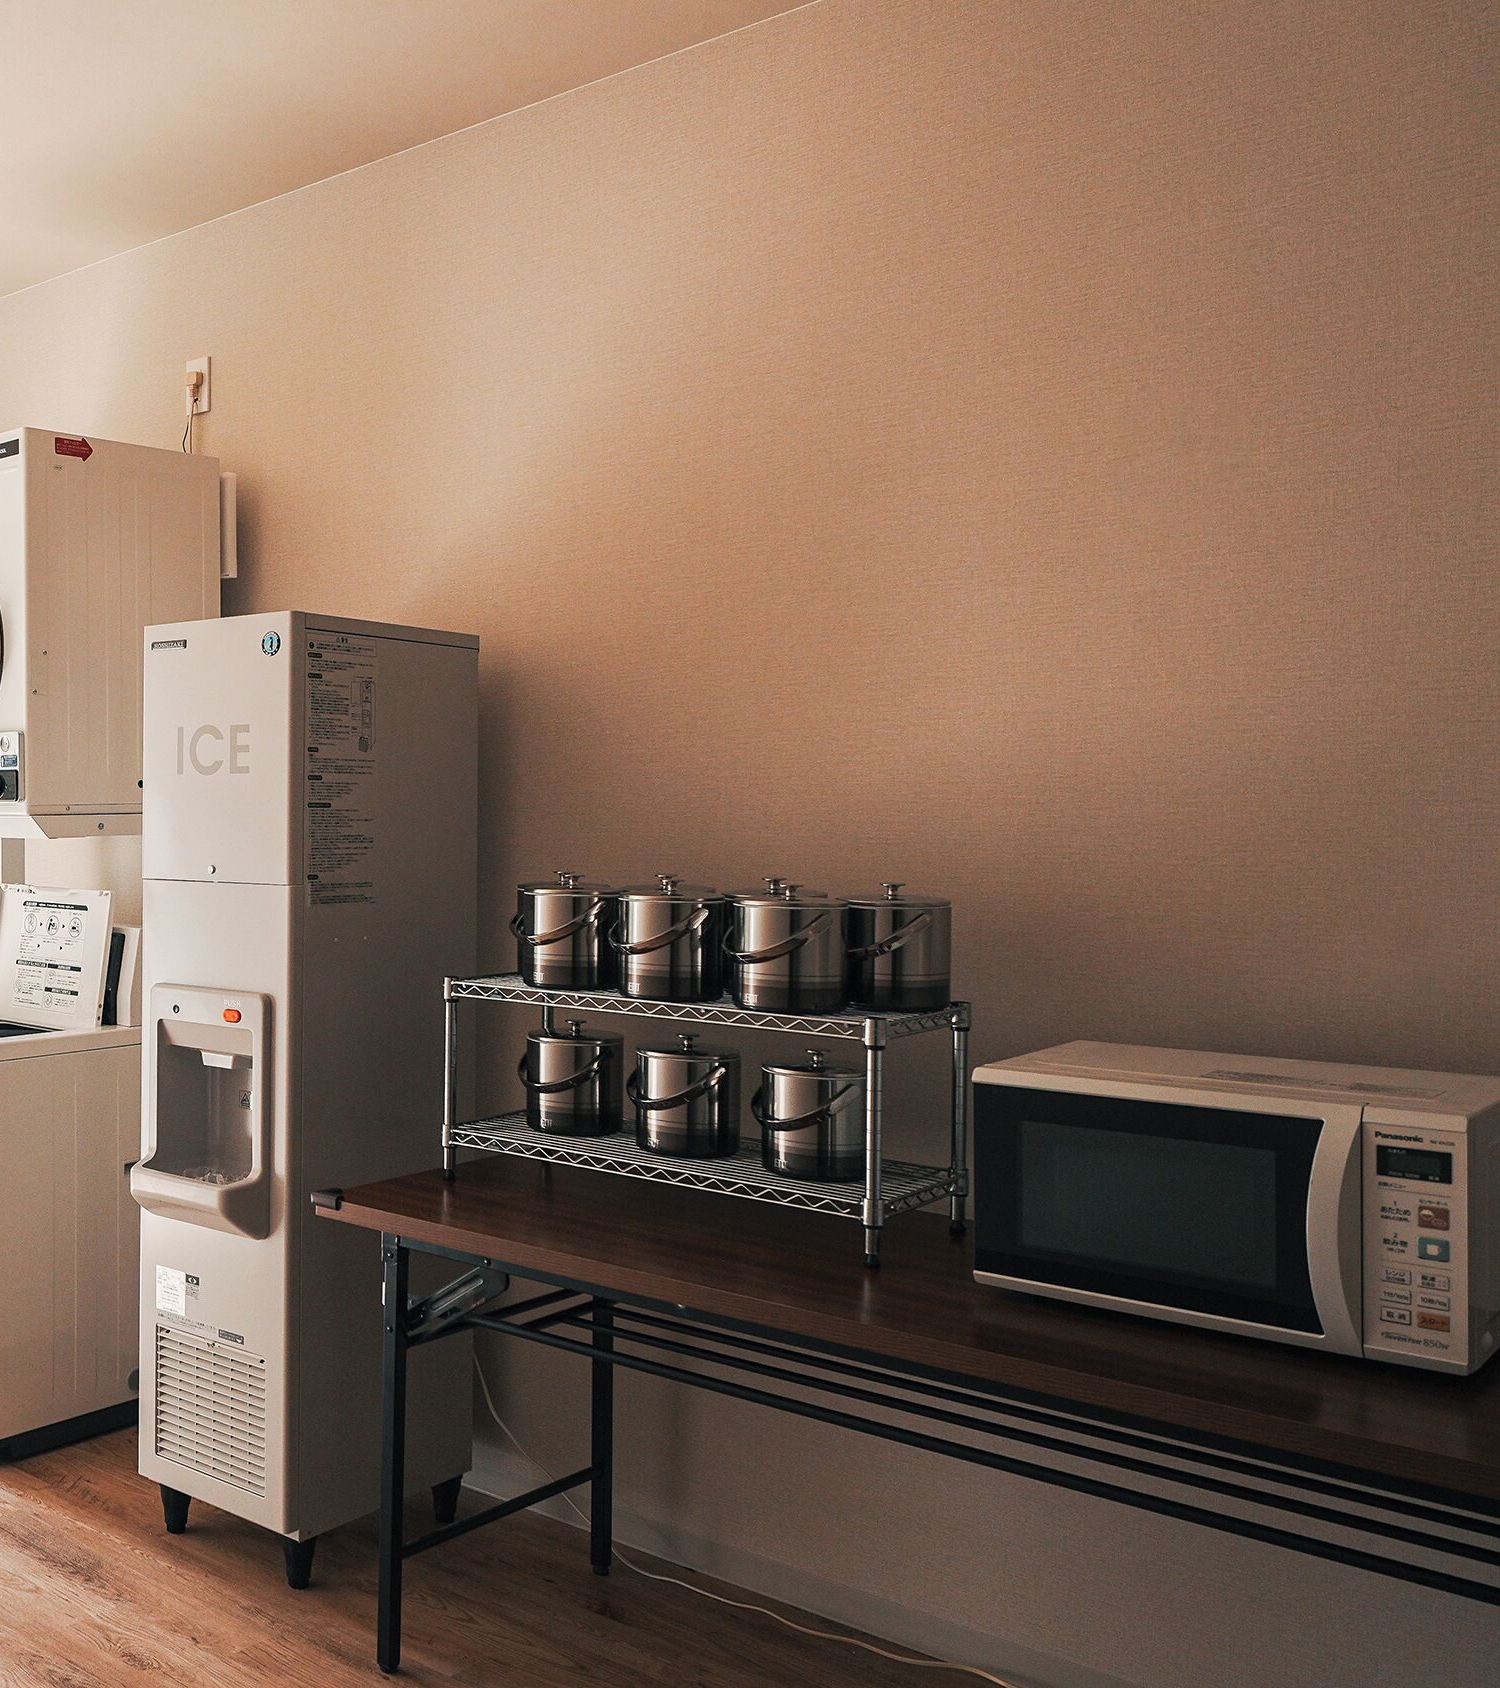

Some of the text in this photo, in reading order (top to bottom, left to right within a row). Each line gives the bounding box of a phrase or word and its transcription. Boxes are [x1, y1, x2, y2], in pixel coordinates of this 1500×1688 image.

[177, 724, 250, 776] ICE
[223, 999, 241, 1008] PUSH
[1374, 1130, 1424, 1143] Panasonic
